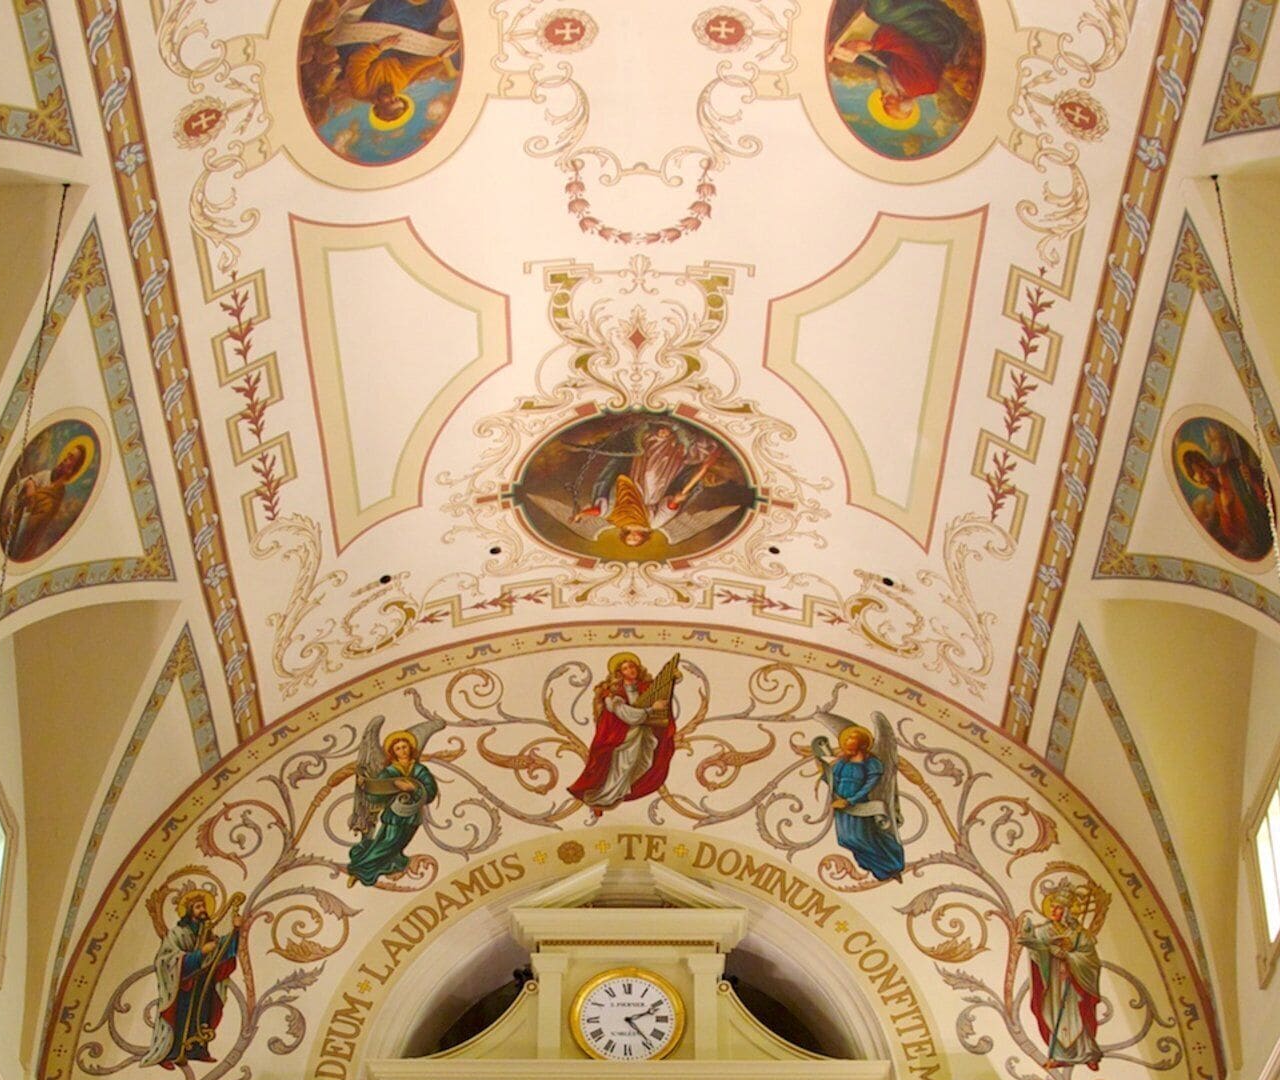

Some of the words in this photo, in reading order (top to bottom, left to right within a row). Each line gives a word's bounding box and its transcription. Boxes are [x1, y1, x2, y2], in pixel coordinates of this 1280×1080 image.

[358, 852, 526, 986] LAUDAMUS
[617, 833, 667, 862] TE
[691, 841, 841, 929] DOMINUM
